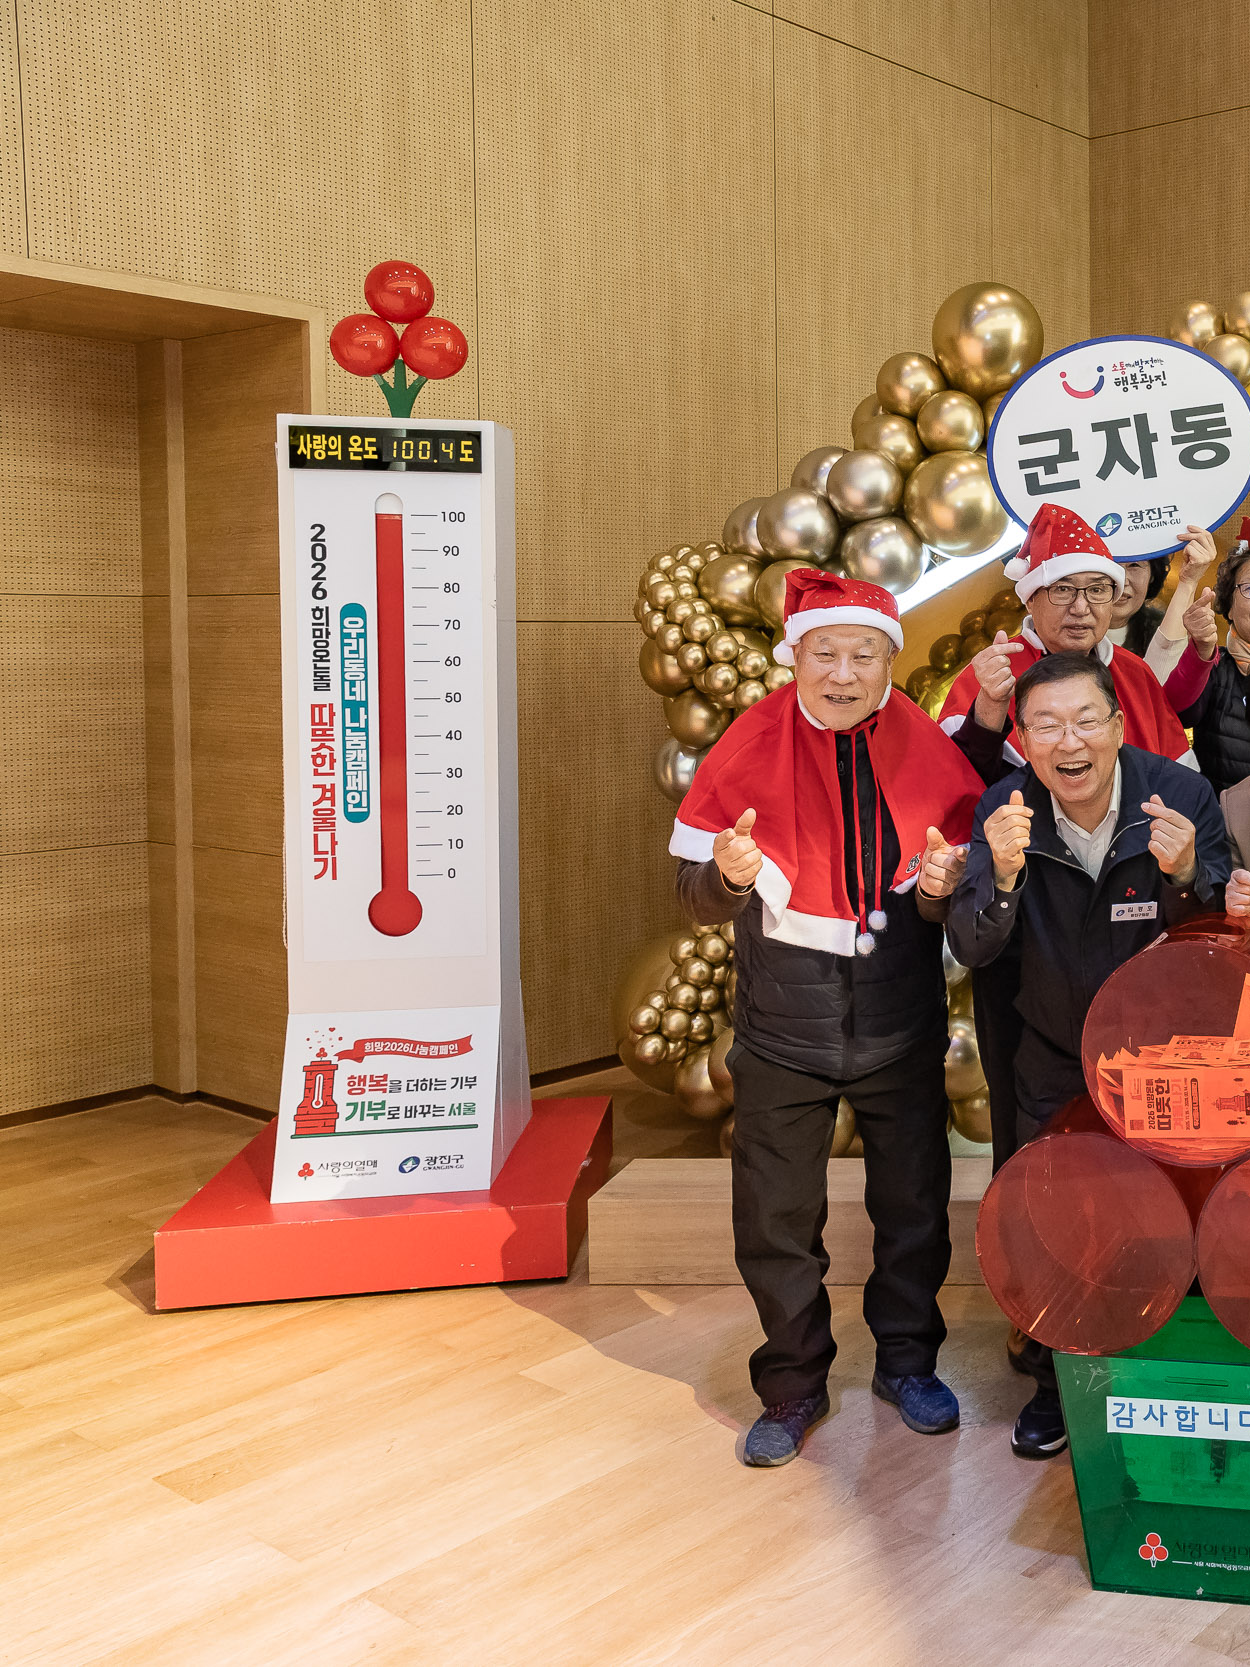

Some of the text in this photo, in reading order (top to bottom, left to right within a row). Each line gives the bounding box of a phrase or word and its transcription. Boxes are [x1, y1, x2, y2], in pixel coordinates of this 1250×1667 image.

[1114, 371, 1167, 392] 행복광진
[297, 434, 342, 460] 사랑의
[348, 435, 378, 461] 온도
[1017, 403, 1232, 496] 군자동
[441, 511, 465, 522] 100
[1127, 505, 1179, 524] 광진구
[442, 545, 459, 557] 90
[443, 582, 460, 593] 80
[310, 523, 331, 691] 2026 희망온돌
[444, 619, 460, 630] 70
[444, 656, 461, 667] 60
[445, 692, 462, 703] 50
[343, 617, 368, 813] 우리동네 나눔캠페인
[445, 730, 462, 741] 40
[446, 768, 463, 779] 30
[310, 703, 338, 881] 따뜻한 겨울나기
[446, 805, 463, 816] 20
[448, 838, 464, 849] 10
[448, 868, 456, 879] 0
[347, 1073, 477, 1096] 행복을 더하는 기부
[1155, 1078, 1171, 1130] 따뜻한
[345, 1100, 476, 1121] 기부로 바꾸는 서울
[318, 1160, 378, 1173] 사랑의열매
[424, 1155, 464, 1166] 광진구
